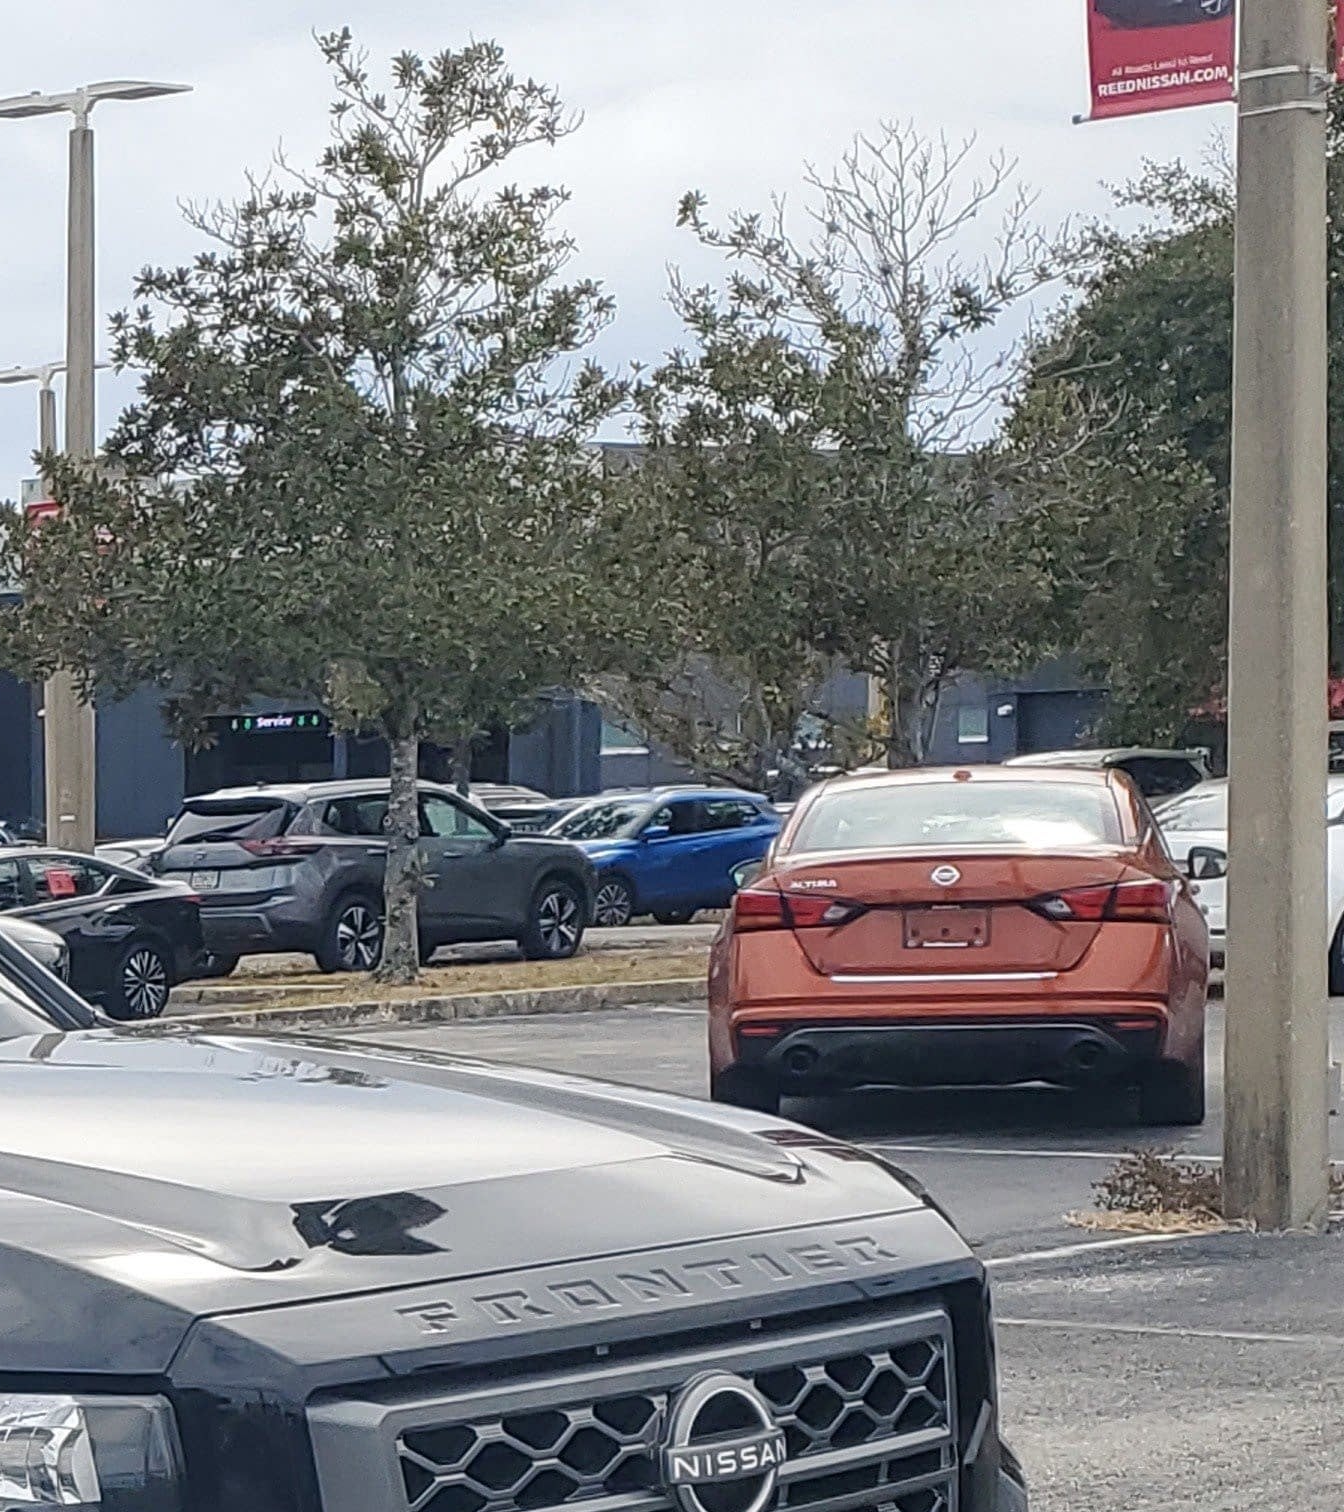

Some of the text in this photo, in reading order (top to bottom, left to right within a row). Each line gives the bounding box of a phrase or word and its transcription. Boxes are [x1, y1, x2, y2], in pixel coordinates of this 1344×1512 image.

[1097, 65, 1229, 98] REEDNISSAN.COM
[393, 1234, 900, 1336] FRONTIER
[673, 1437, 787, 1480] NISSAN
